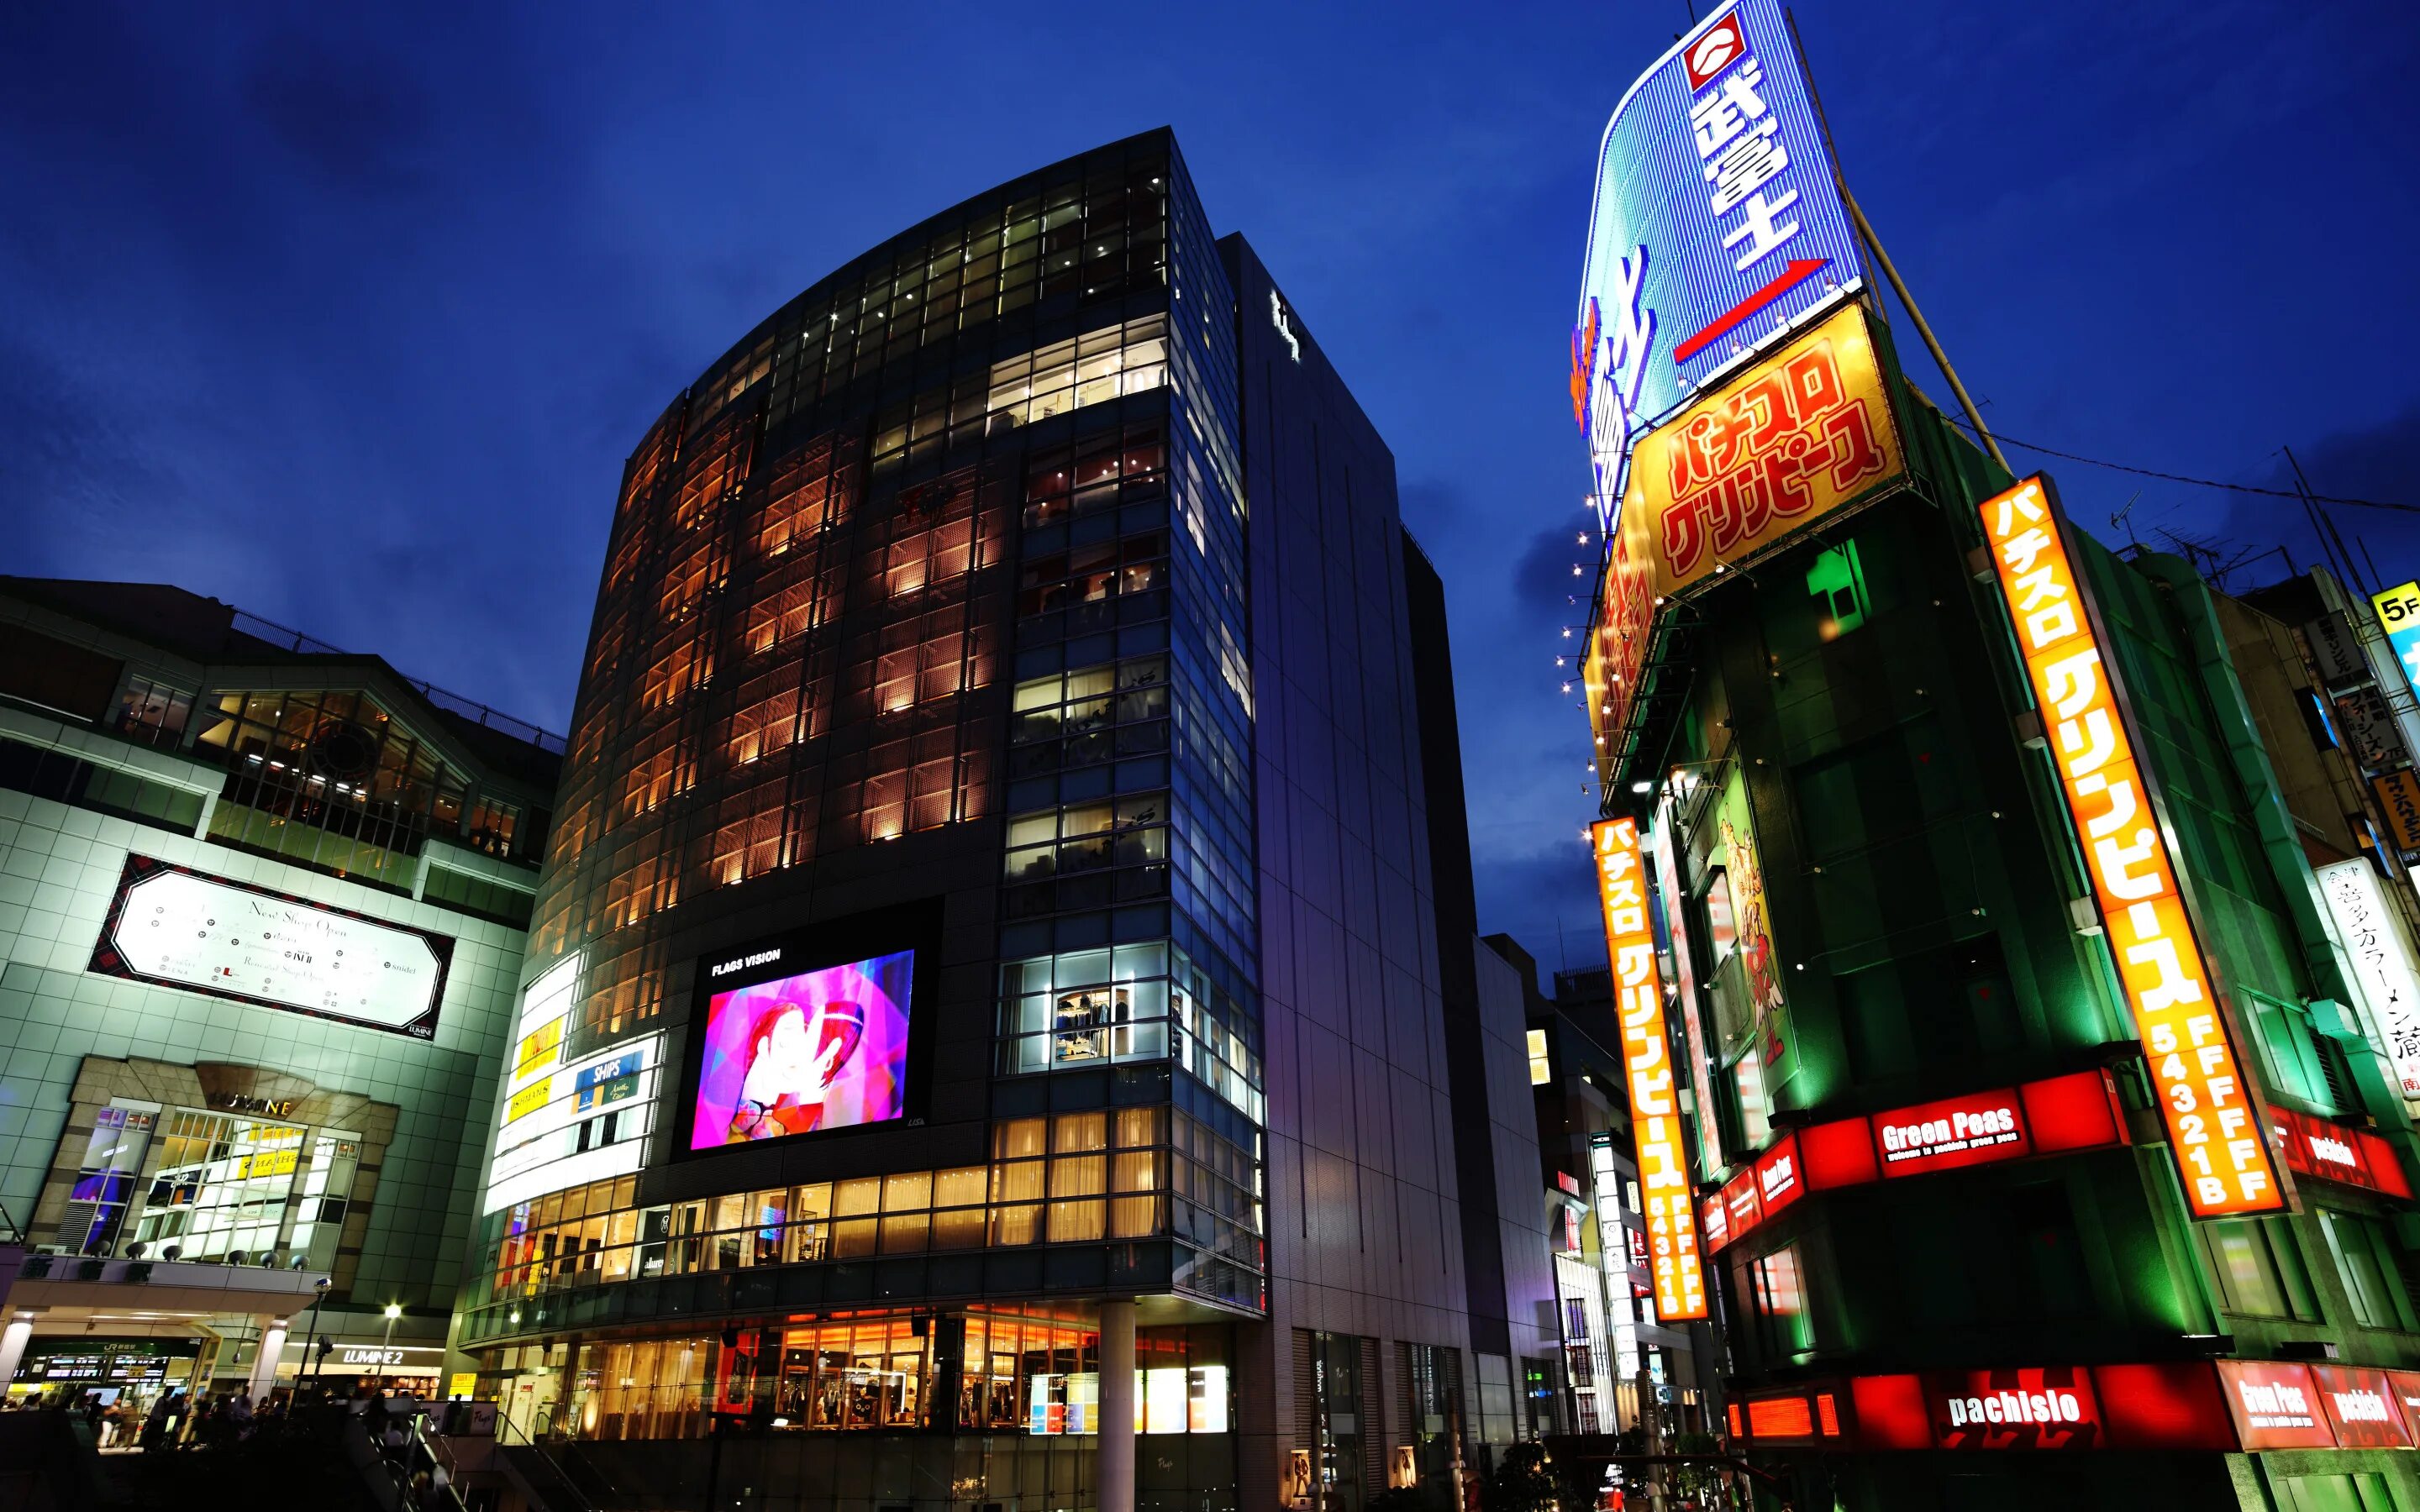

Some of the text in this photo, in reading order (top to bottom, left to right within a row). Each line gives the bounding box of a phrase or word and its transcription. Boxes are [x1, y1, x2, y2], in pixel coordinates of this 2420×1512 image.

[1690, 57, 1800, 271] 武富士
[1669, 338, 1845, 501] パチスロ
[1661, 398, 1885, 578] グリンピース
[1996, 485, 2078, 649] パチスロ
[1601, 821, 1644, 935] パチスロ
[249, 901, 278, 919] New
[282, 910, 312, 932] Shop
[316, 920, 347, 937] Open
[392, 963, 416, 974] snidel
[712, 948, 781, 977] FLAGS VISION
[409, 1026, 433, 1036] LUMINE
[593, 1059, 621, 1083] SHIPS
[1882, 1107, 2015, 1151] Green Peas
[343, 1350, 403, 1364] LUMINE 2
[1949, 1389, 2081, 1427] pachislo
